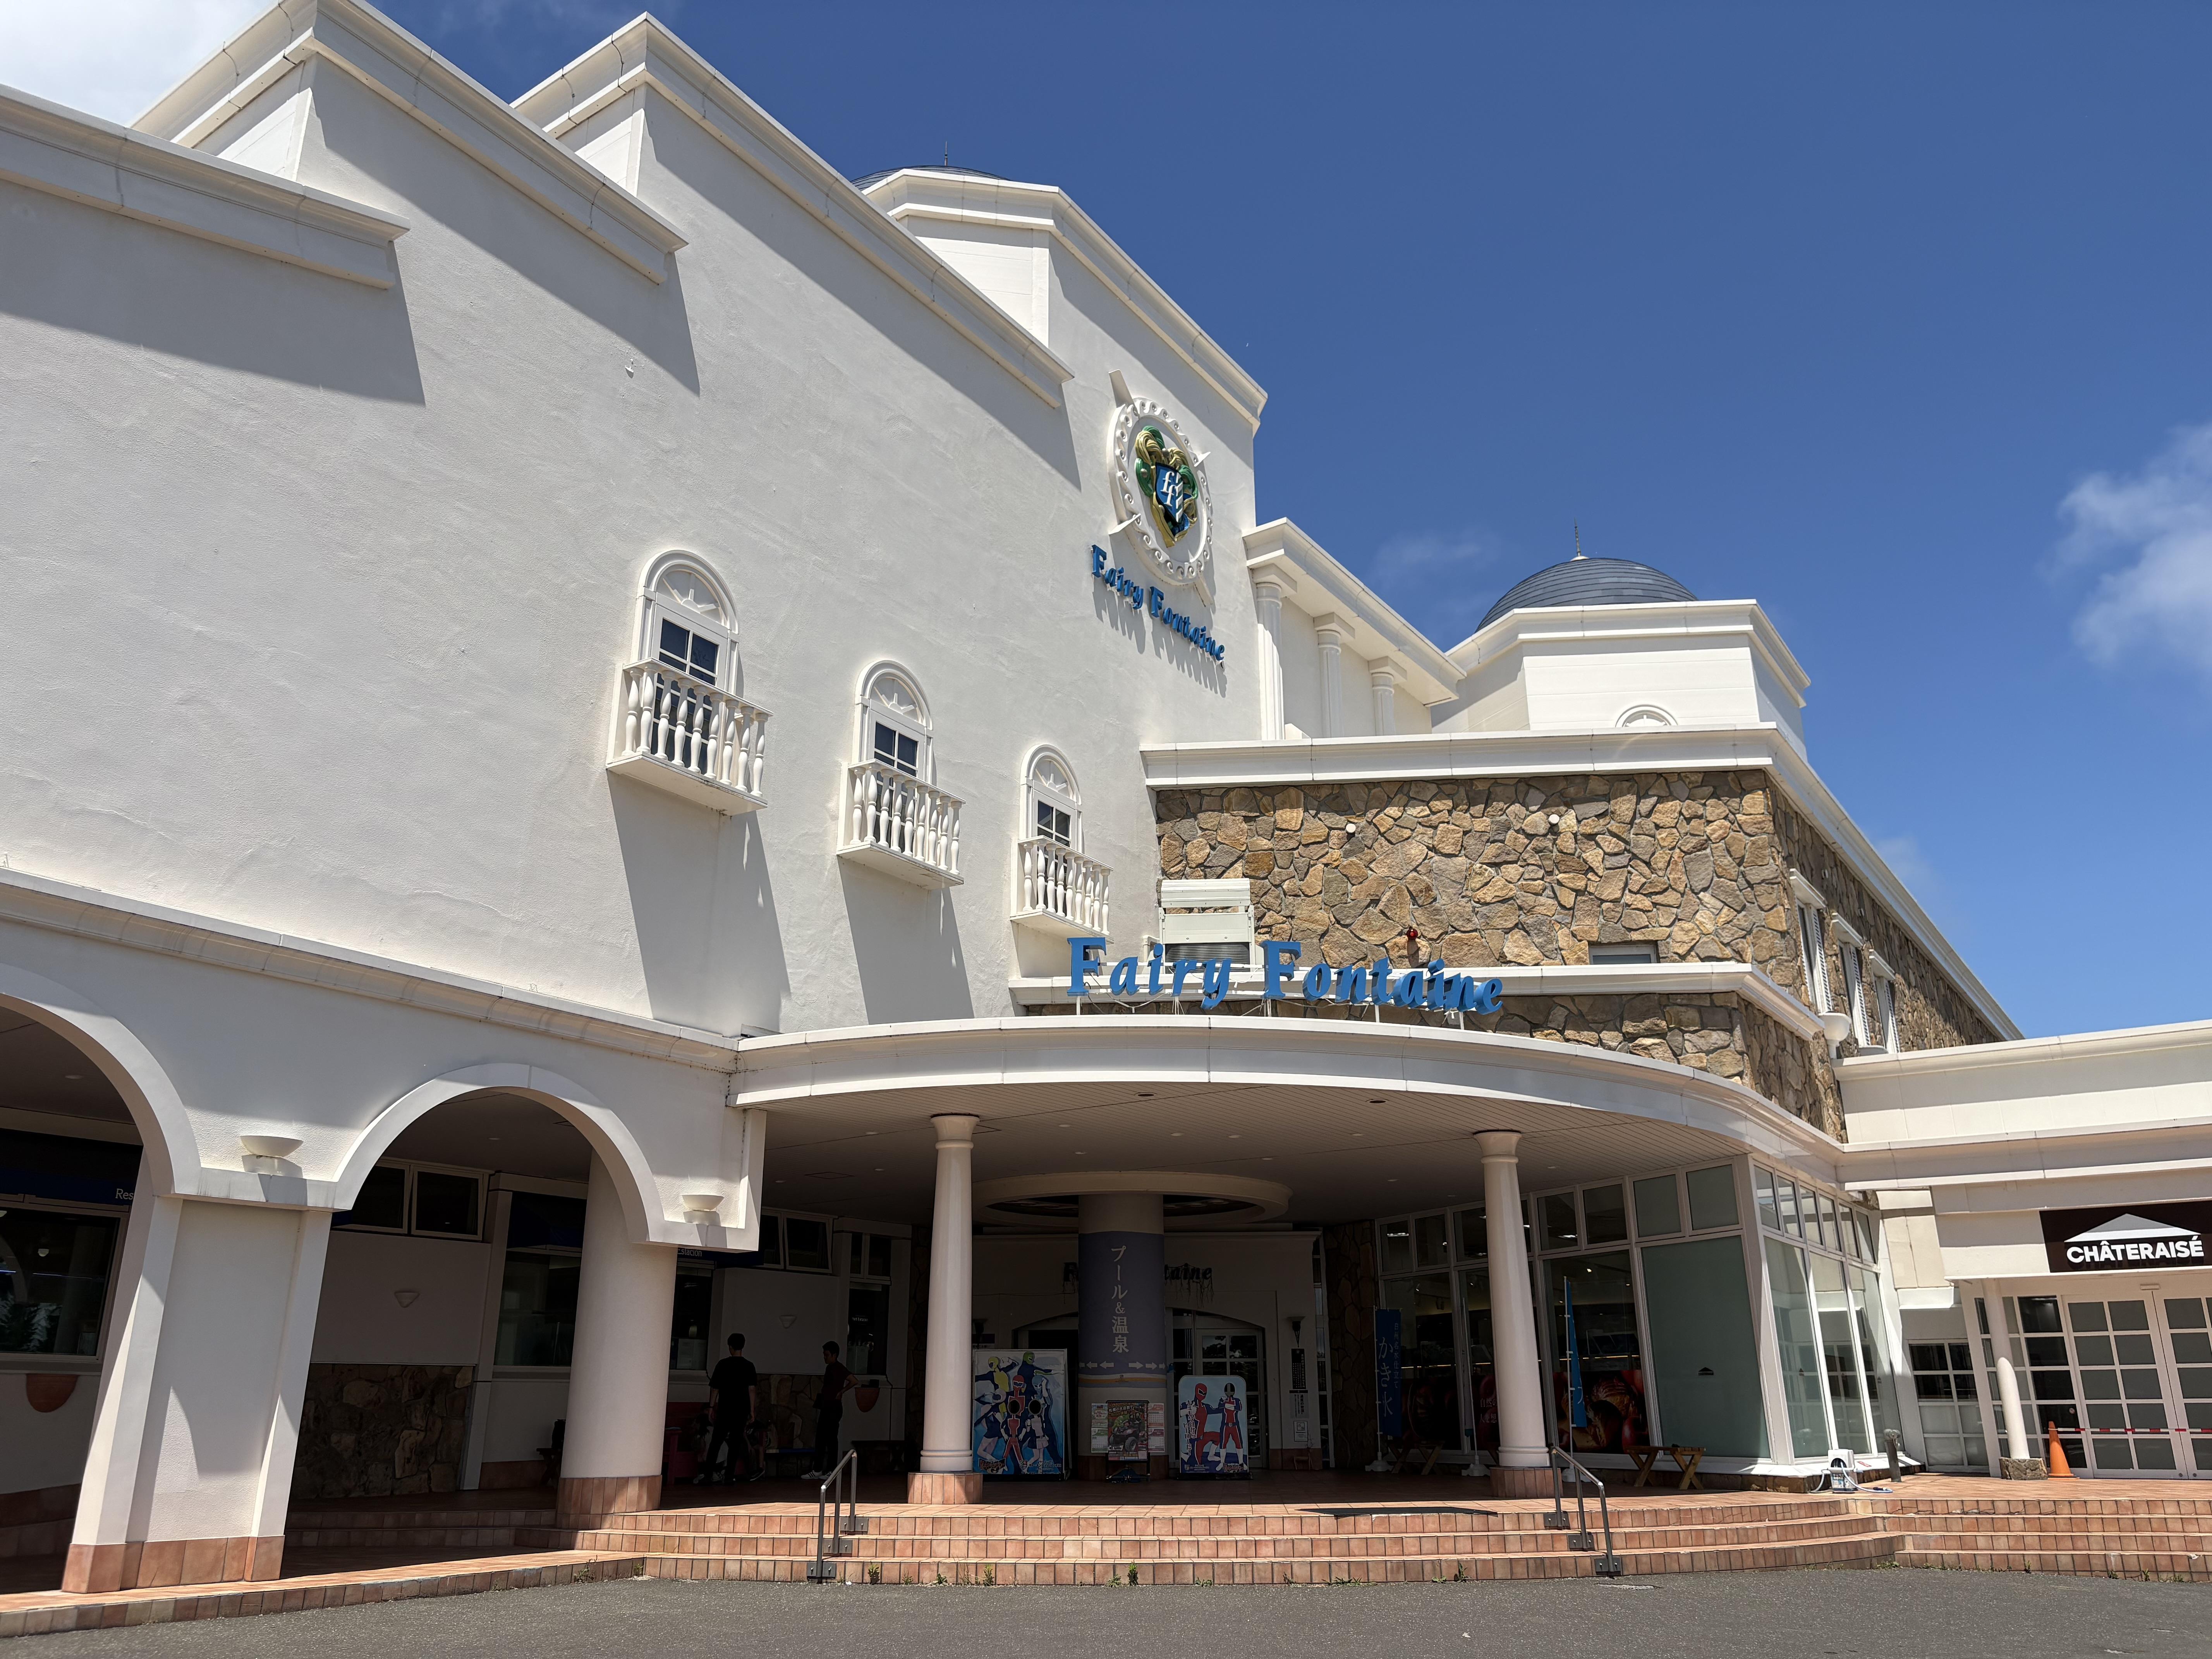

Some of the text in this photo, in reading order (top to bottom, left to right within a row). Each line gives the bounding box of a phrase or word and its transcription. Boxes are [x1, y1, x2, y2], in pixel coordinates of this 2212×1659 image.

[1091, 544, 1225, 661] Fairy Fontaine
[1067, 937, 1503, 1015] Fairy Fontaine
[115, 1188, 134, 1200] Res
[1165, 1263, 1212, 1280] taine
[2066, 1235, 2204, 1263] CHÂTERAISÉ
[1111, 1245, 1130, 1353] プール&温泉
[1379, 1336, 1393, 1417] かき氷
